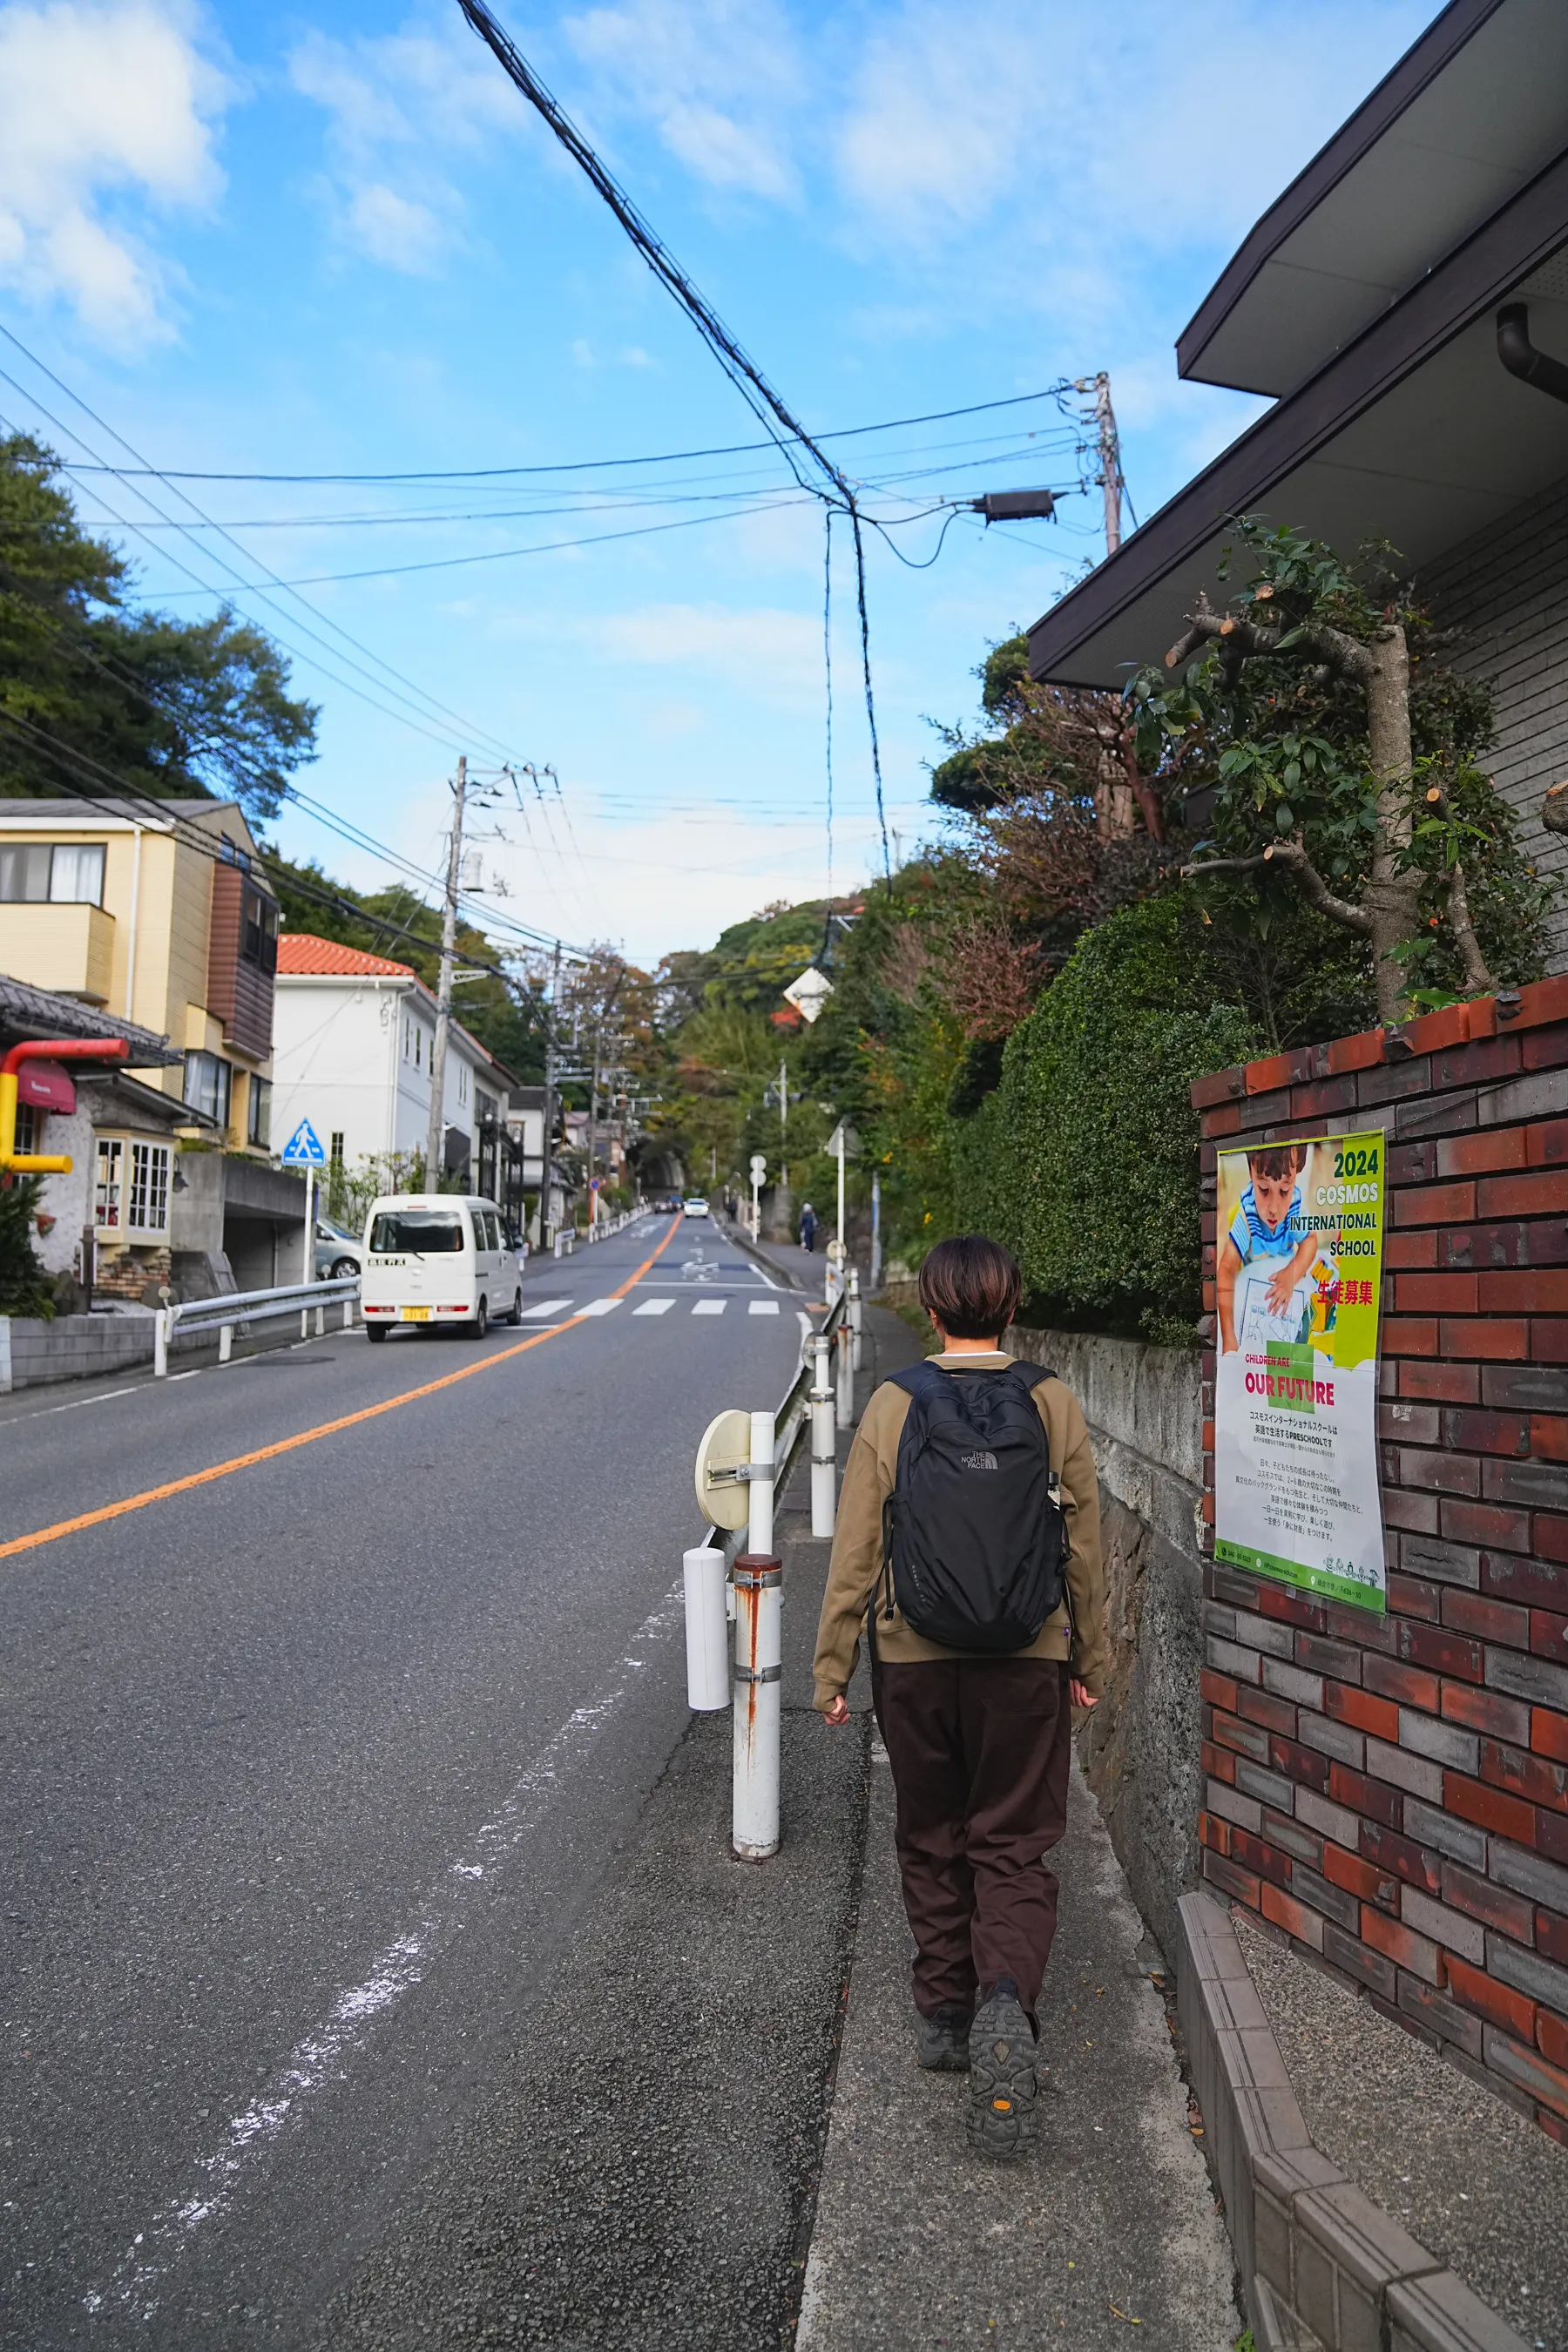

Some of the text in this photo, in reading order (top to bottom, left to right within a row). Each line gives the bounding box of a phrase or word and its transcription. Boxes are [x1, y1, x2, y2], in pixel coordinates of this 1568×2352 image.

[1334, 1149, 1378, 1178] 2024
[1316, 1181, 1378, 1206] COSMOS
[1290, 1212, 1377, 1231] INTERNATIONAL
[1329, 1240, 1376, 1256] SCHOOL
[1316, 1279, 1373, 1306] 生徒募集
[1245, 1354, 1290, 1368] CHILDREN ARE
[1245, 1372, 1335, 1406] OUR FUTURE
[1249, 1411, 1338, 1436] コスモスインターナショナルスクールは
[1254, 1424, 1333, 1448] 英語で生活するPRESCHOOLです
